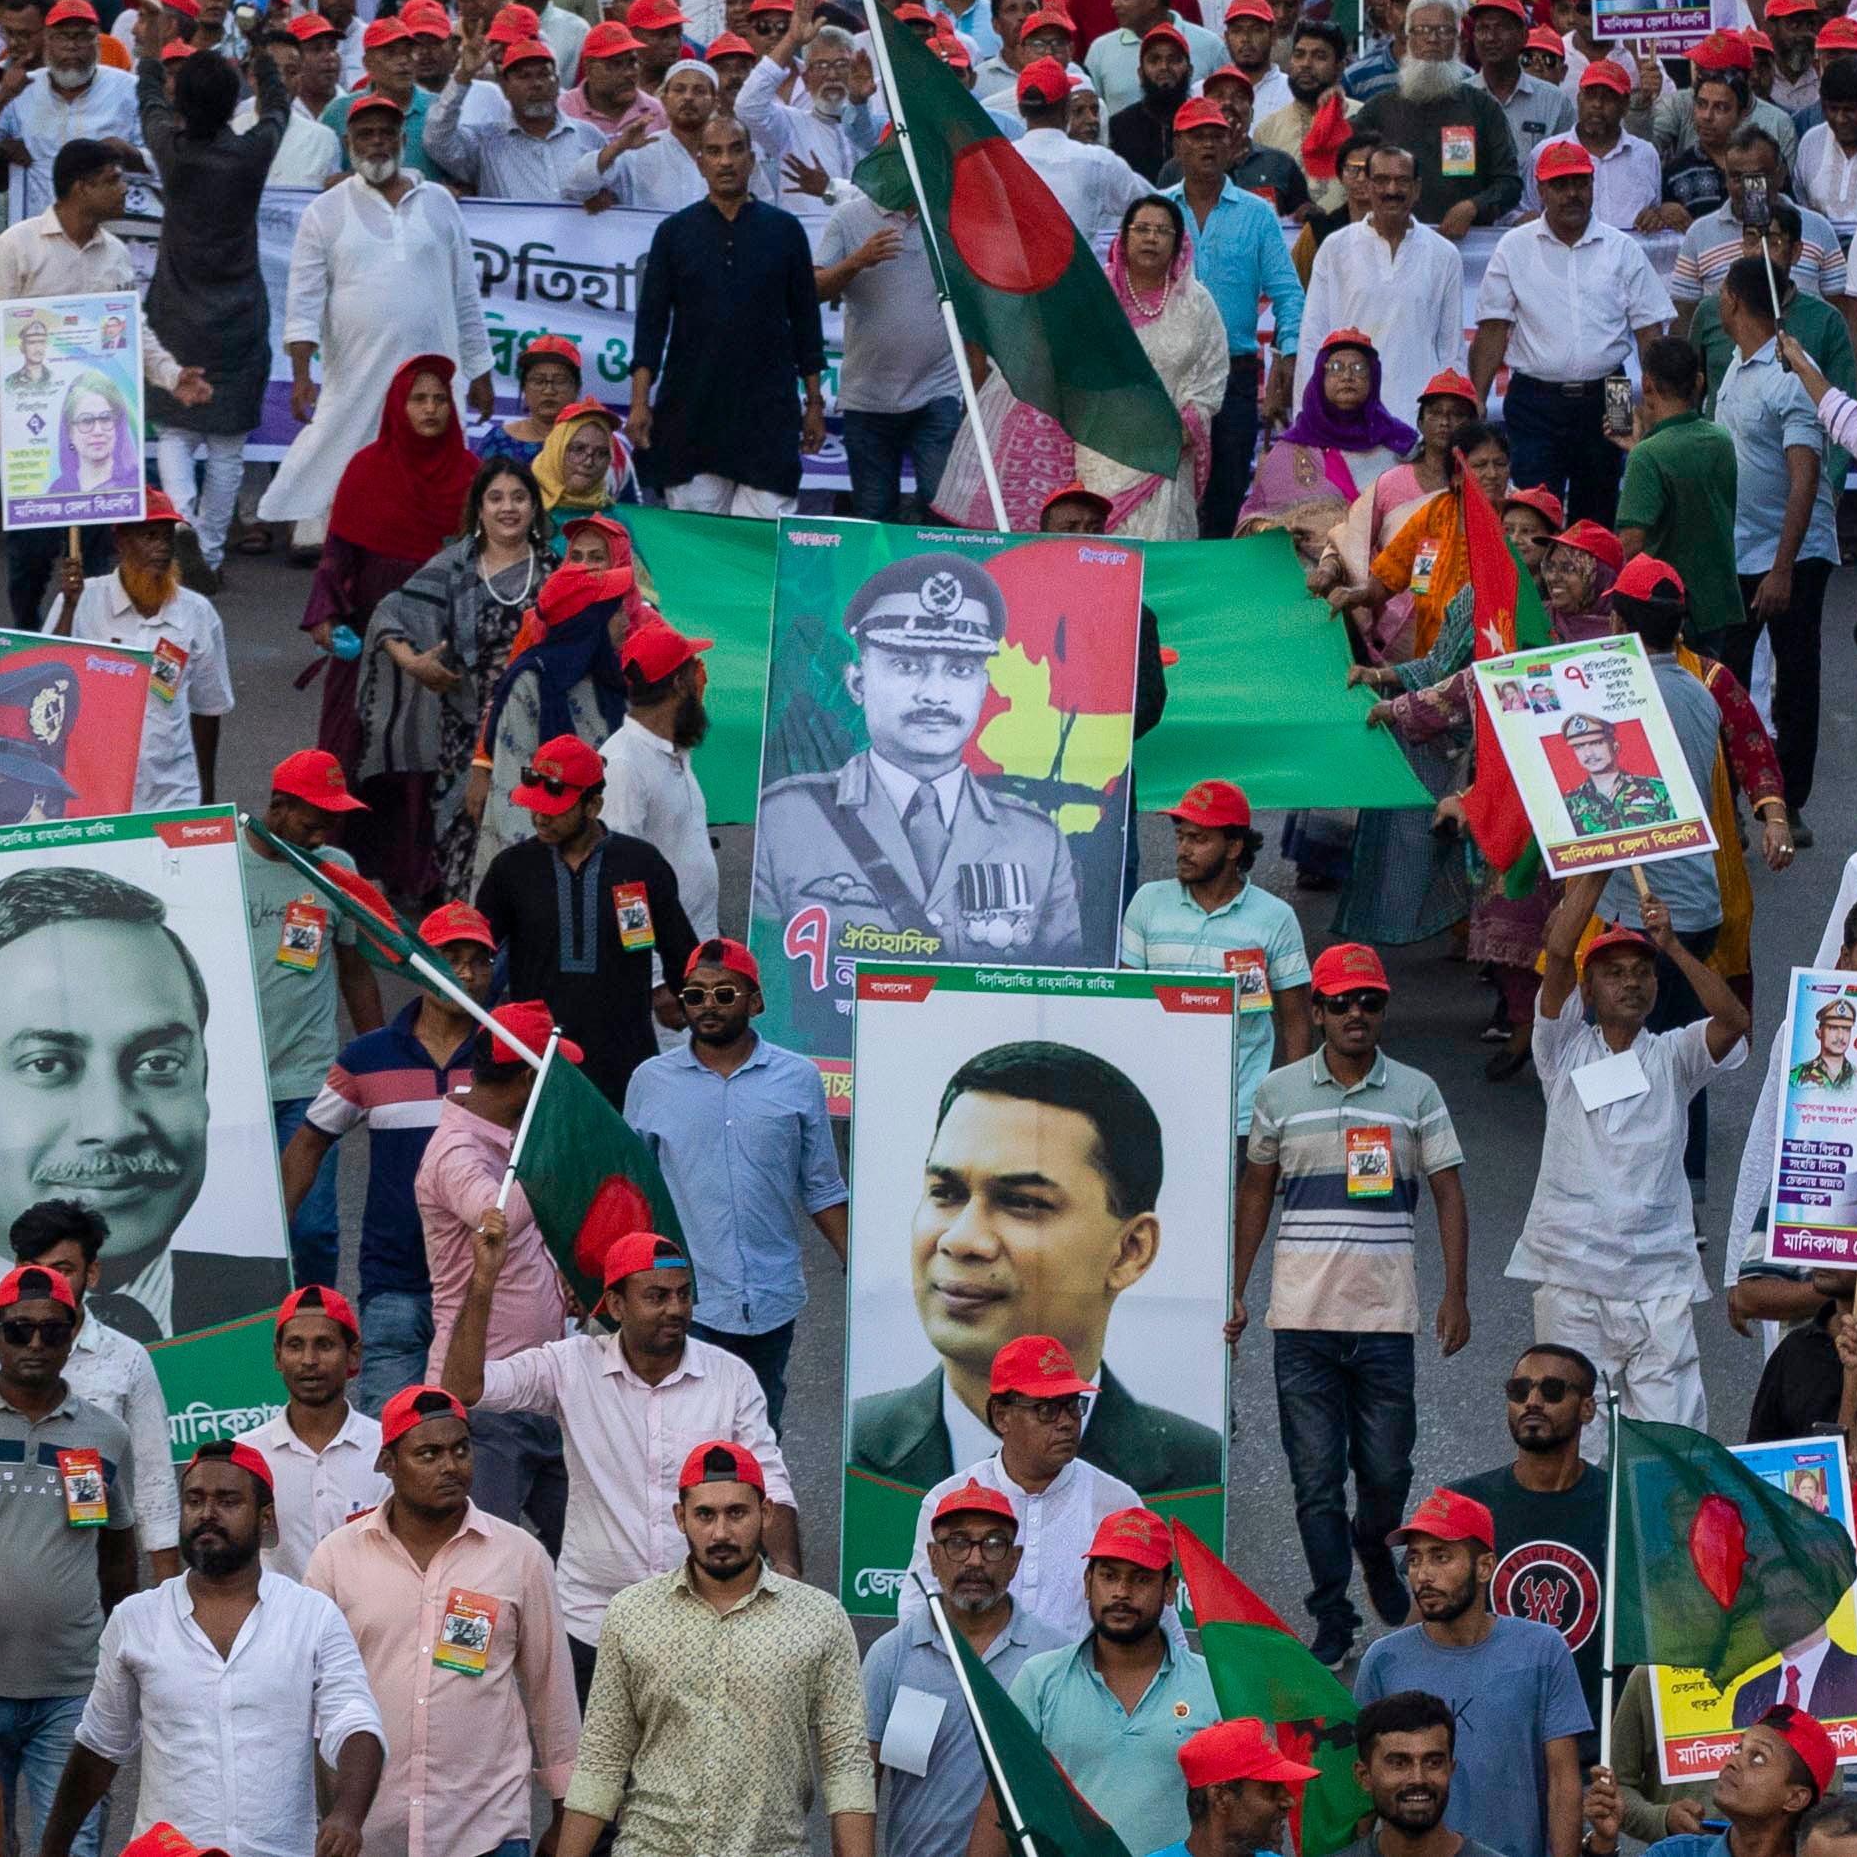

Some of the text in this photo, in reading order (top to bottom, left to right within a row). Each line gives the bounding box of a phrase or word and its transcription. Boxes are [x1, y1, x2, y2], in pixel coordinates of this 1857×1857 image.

[1565, 665, 1589, 689] ৭
[85, 822, 115, 839] রাহিম
[182, 824, 222, 840] জিন্দাবাদ
[1557, 826, 1700, 865] মানিকগঞ্জ জেলা বিএনপি
[783, 905, 829, 992] ৭
[838, 923, 941, 957] ঐতিহাসিক
[870, 980, 912, 995] বাংলাদেশ
[1086, 975, 1115, 991] রাহিম
[1181, 992, 1219, 1007] জিন্দাবাদ
[1783, 1230, 1848, 1256] মানিকগঞ্জ
